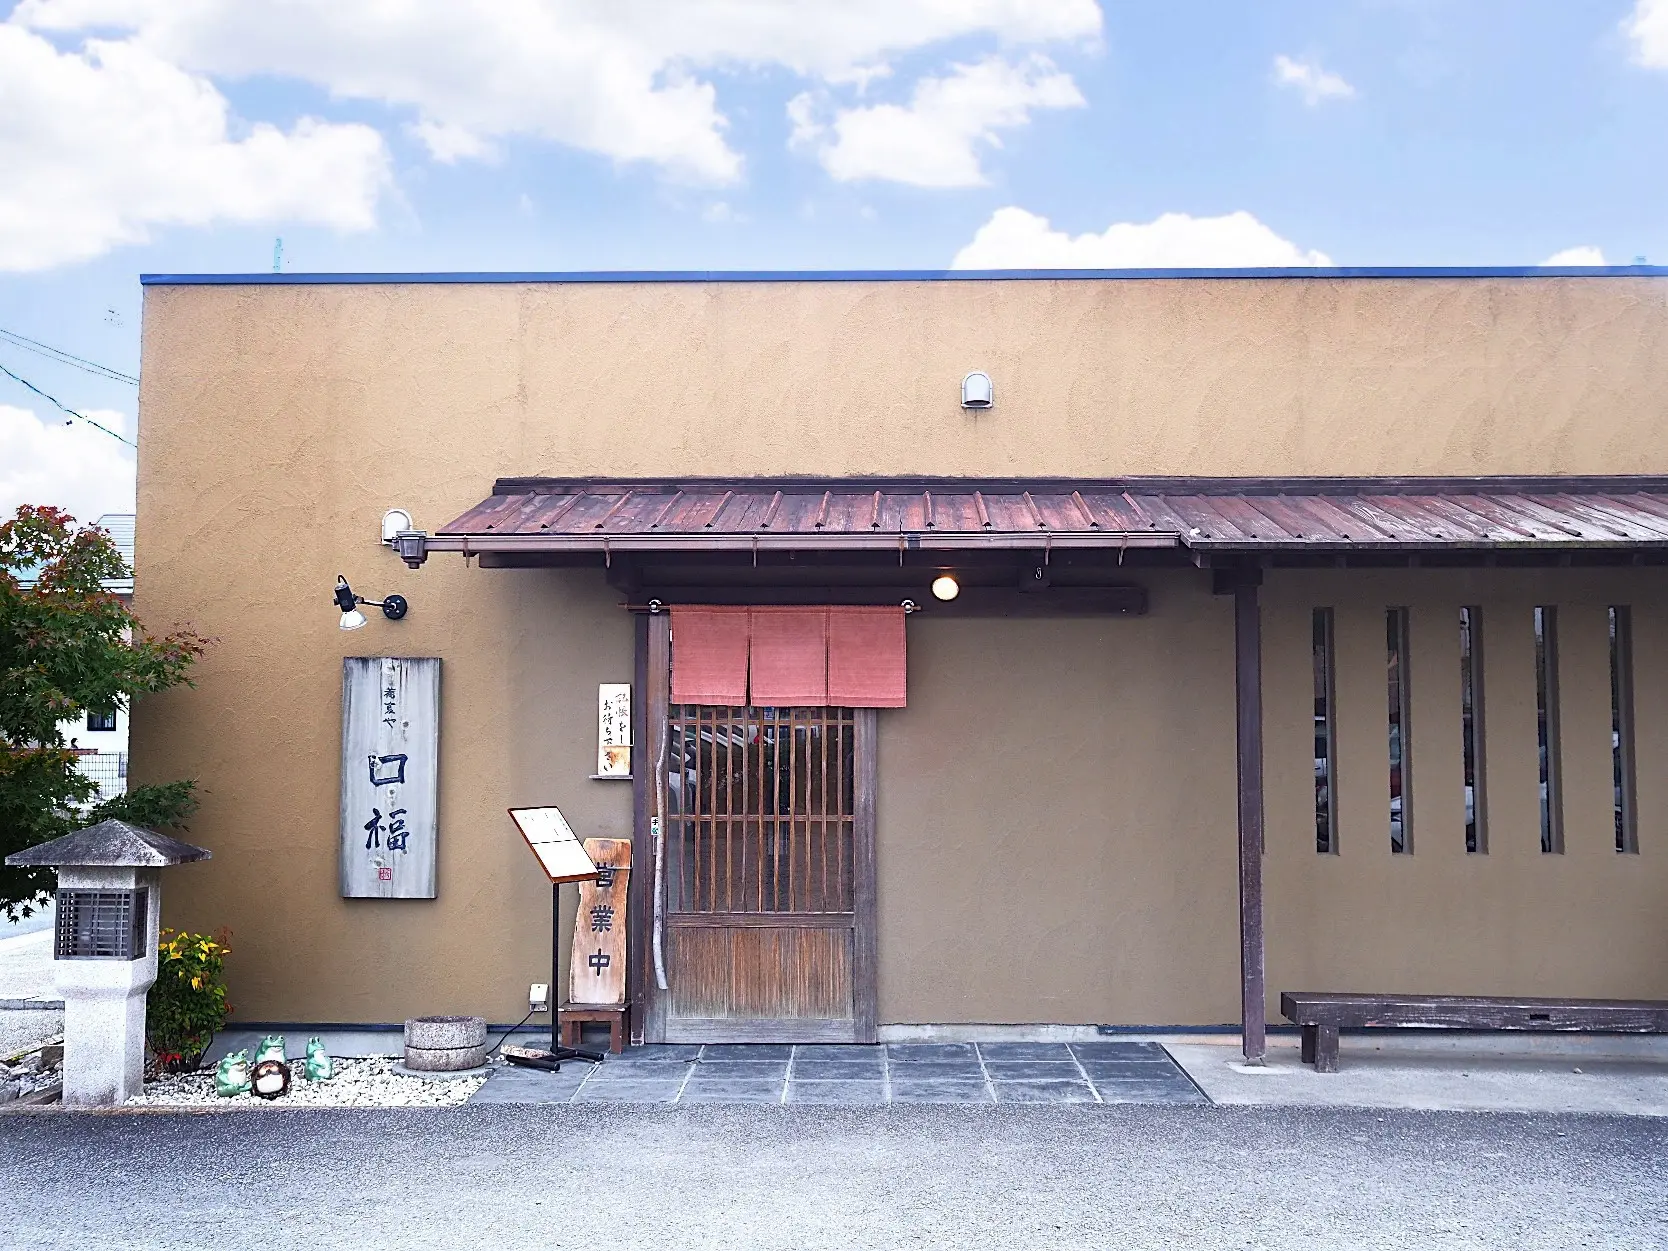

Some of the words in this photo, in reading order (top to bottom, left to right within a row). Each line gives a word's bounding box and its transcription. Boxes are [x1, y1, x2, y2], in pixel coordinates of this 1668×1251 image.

[383, 687, 397, 728] 蕎麦や
[364, 753, 409, 850] 口福
[589, 862, 615, 976] 営業中
